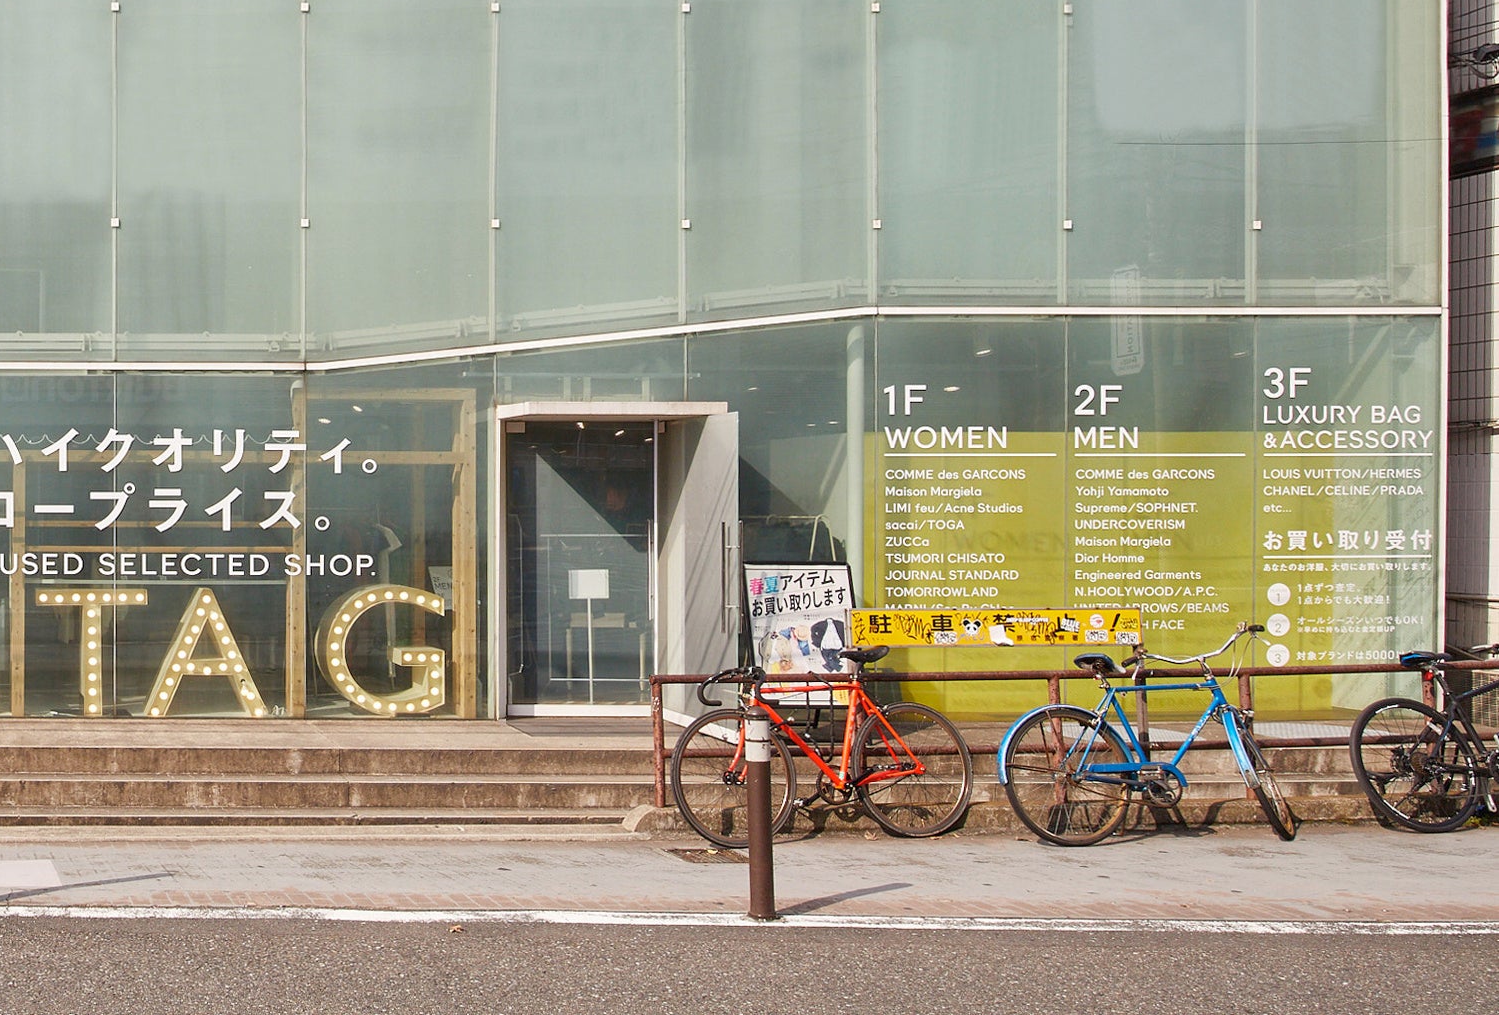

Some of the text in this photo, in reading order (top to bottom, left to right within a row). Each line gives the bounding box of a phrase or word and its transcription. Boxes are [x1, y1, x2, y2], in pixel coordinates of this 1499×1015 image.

[1263, 367, 1312, 399] 3F
[883, 384, 927, 416] 1F
[1074, 384, 1123, 416] 2F
[1263, 405, 1421, 424] LUXURY BAG
[884, 426, 1008, 449] WOMEN
[1074, 426, 1139, 449] MEN
[1263, 430, 1434, 449] &ACCESSORY
[885, 469, 1026, 480] COMME des GARCONS
[1076, 469, 1215, 480] COMME des GARCONS
[1263, 469, 1422, 479] LOUIS VUITTON/HERMES
[885, 487, 982, 499] Maison Margiela
[1076, 487, 1169, 499] Yohji Yamamoto
[1263, 485, 1424, 496] CHANEL/CELINE/PRADA
[885, 503, 1023, 513] LIMI feu/Acne Studios
[1075, 503, 1198, 515] Supreme/SOPHNET.
[885, 520, 965, 530] sacai/TOGA
[1075, 519, 1186, 530] UNDERCOVERISM
[885, 537, 930, 547] ZUCCa
[1075, 537, 1171, 549] Maison Margiela
[1263, 530, 1432, 551] お買い取り受付
[885, 553, 1005, 564] TSUMORI CHISATO
[1075, 553, 1145, 563] Dior Homme
[0, 552, 85, 577] USED
[99, 552, 269, 577] SELECTED
[284, 553, 377, 577] SHOP.
[885, 570, 1019, 581] JOURNAL STANDARD
[1075, 570, 1201, 582] Engineered Garments
[750, 570, 835, 596] 春夏アイテム
[885, 587, 998, 597] TOMORROWLAND
[1075, 586, 1218, 597] N.HOOLYWOOD/A.P.C.
[752, 587, 846, 617] お買い取りします
[1153, 620, 1185, 630] FACE
